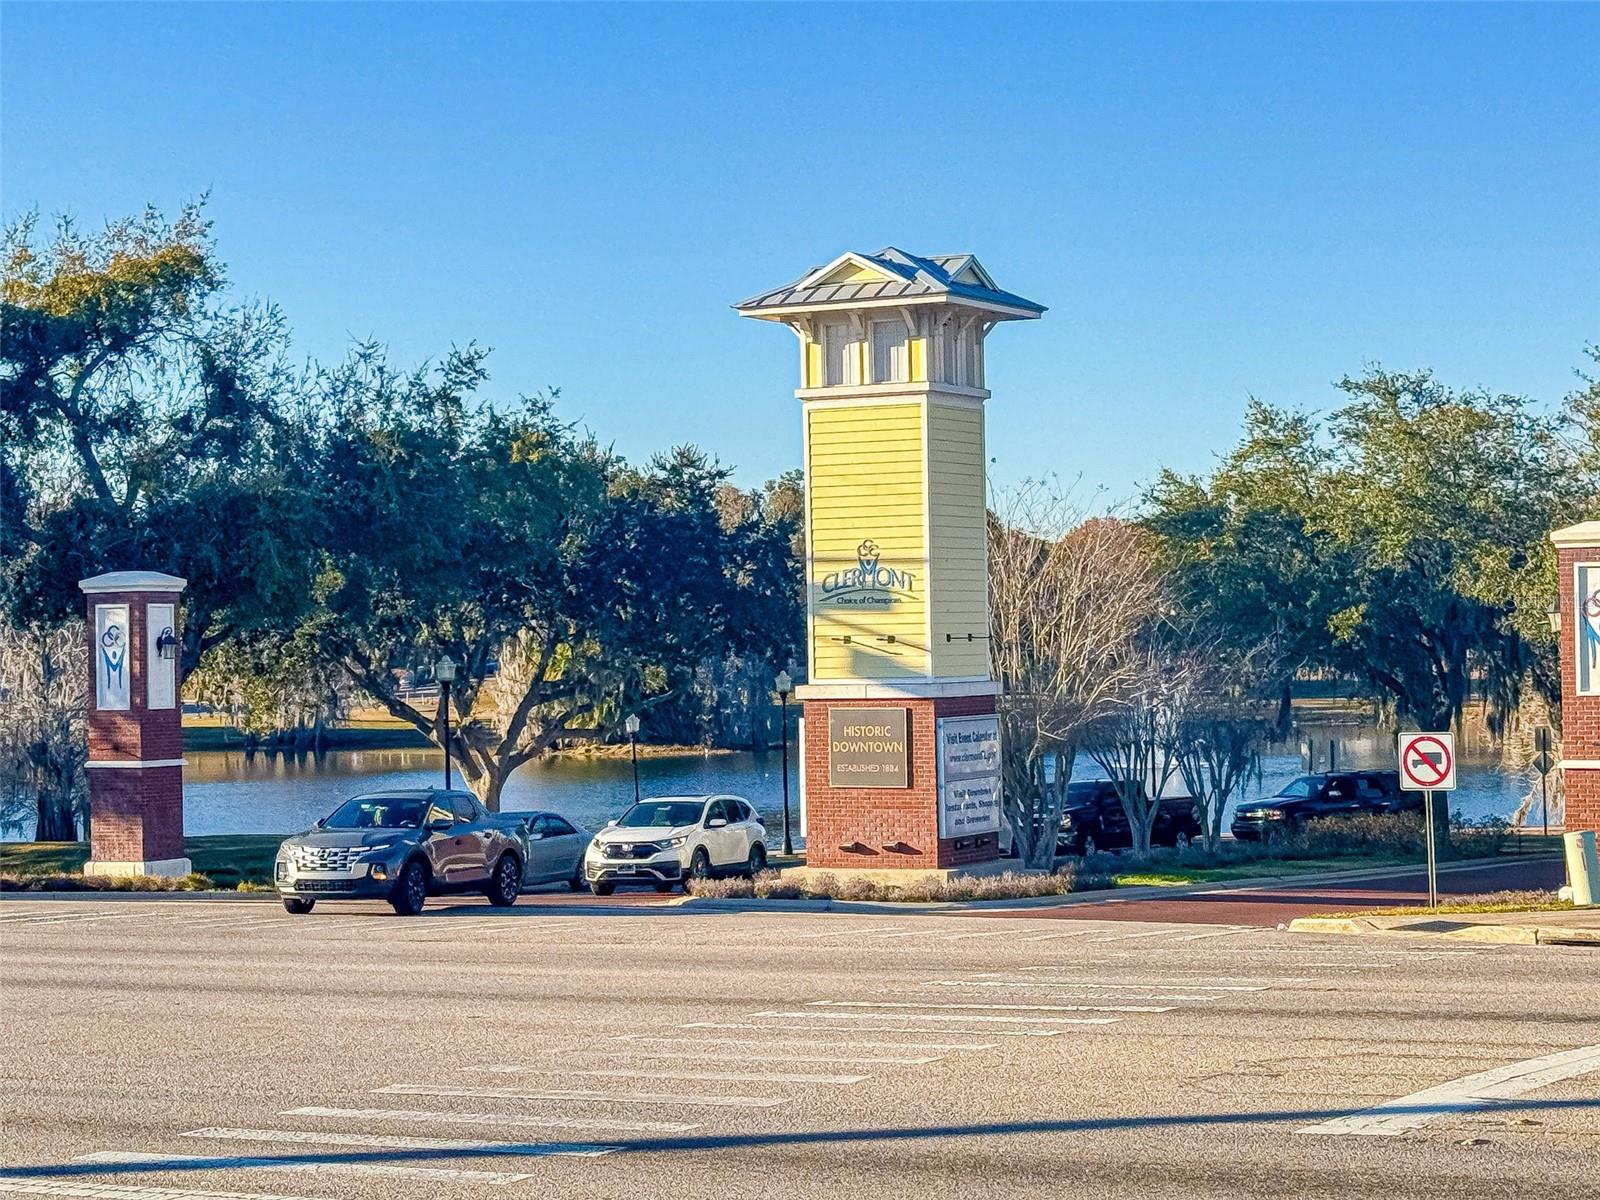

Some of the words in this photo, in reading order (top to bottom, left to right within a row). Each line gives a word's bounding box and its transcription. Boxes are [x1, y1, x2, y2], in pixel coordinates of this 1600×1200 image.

[821, 559, 917, 593] CLERMONT
[859, 596, 866, 604] of
[843, 725, 892, 737] HISTORIC
[946, 733, 958, 745] Visit
[958, 732, 972, 744] Event
[832, 741, 903, 753] DOWNTOWN
[837, 764, 880, 773] ESTABLISHED
[954, 817, 965, 826] and
